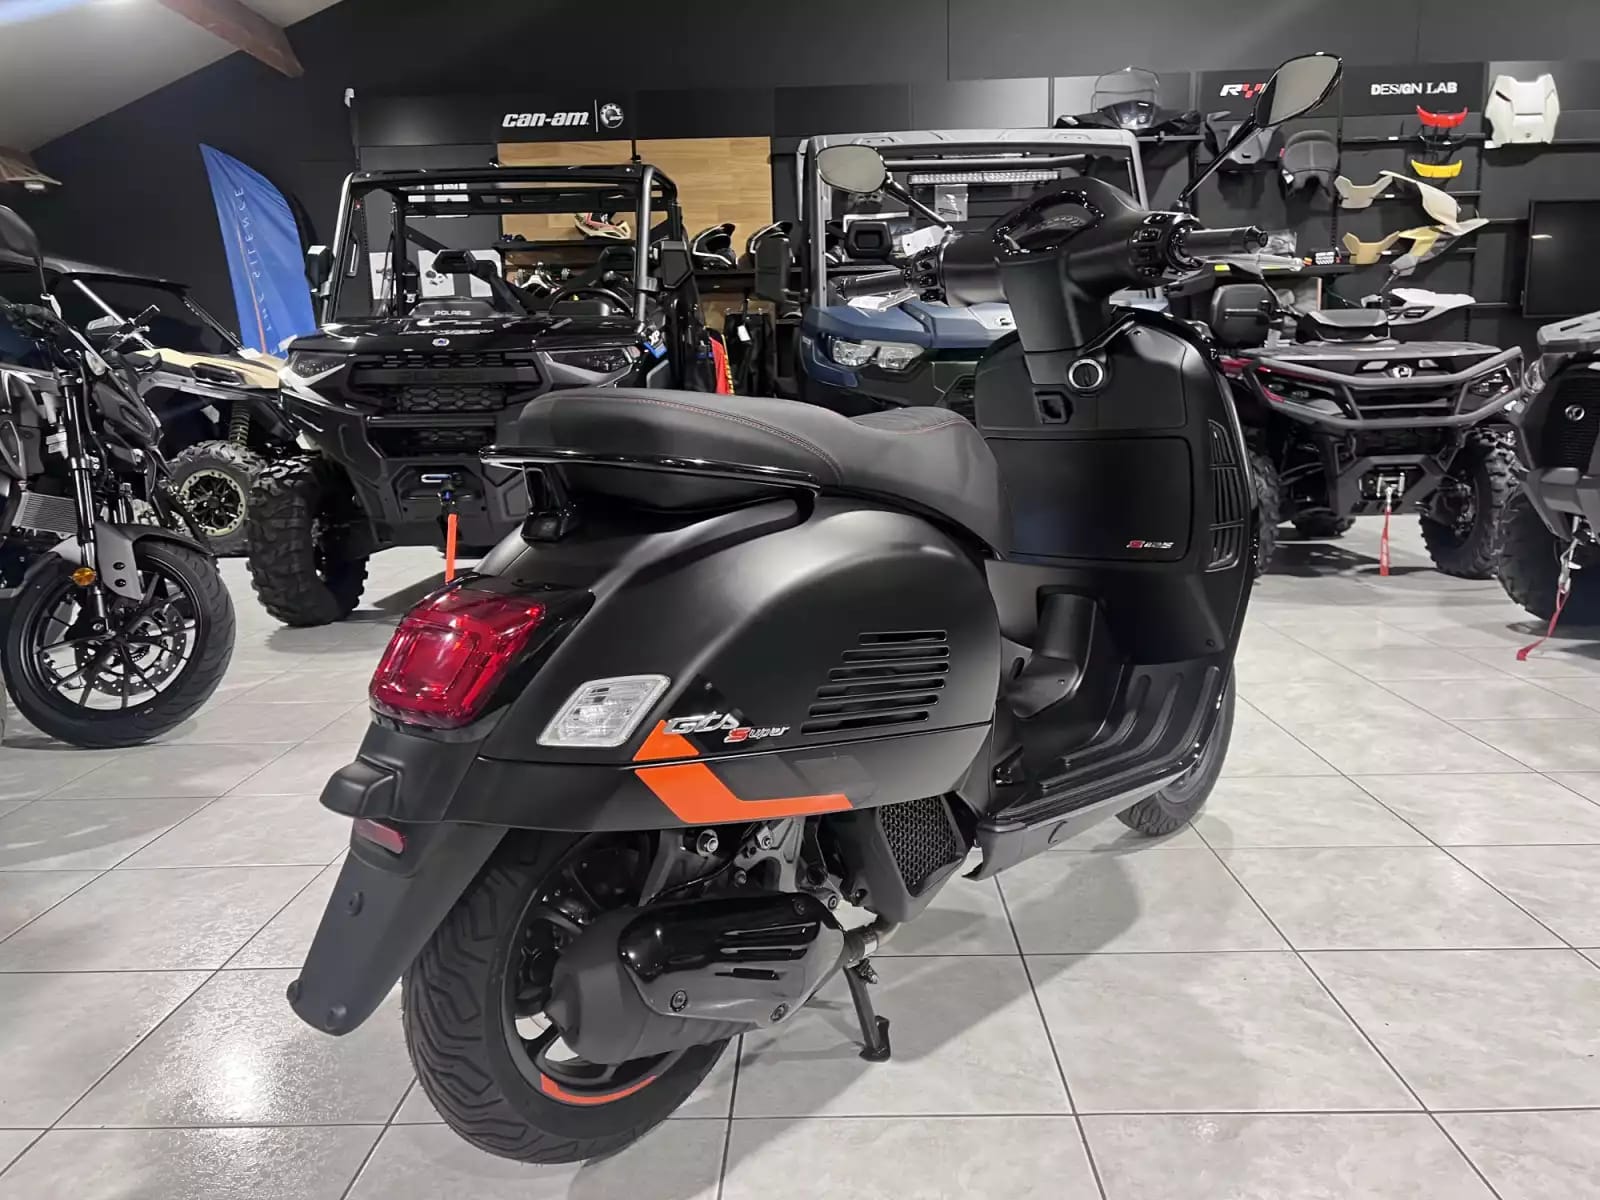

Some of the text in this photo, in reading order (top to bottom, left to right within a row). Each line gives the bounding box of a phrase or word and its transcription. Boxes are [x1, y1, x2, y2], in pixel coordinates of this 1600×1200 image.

[1219, 83, 1267, 98] RY
[1370, 82, 1458, 96] DESIGN LAB
[502, 111, 589, 128] can-am
[723, 726, 790, 744] Super
